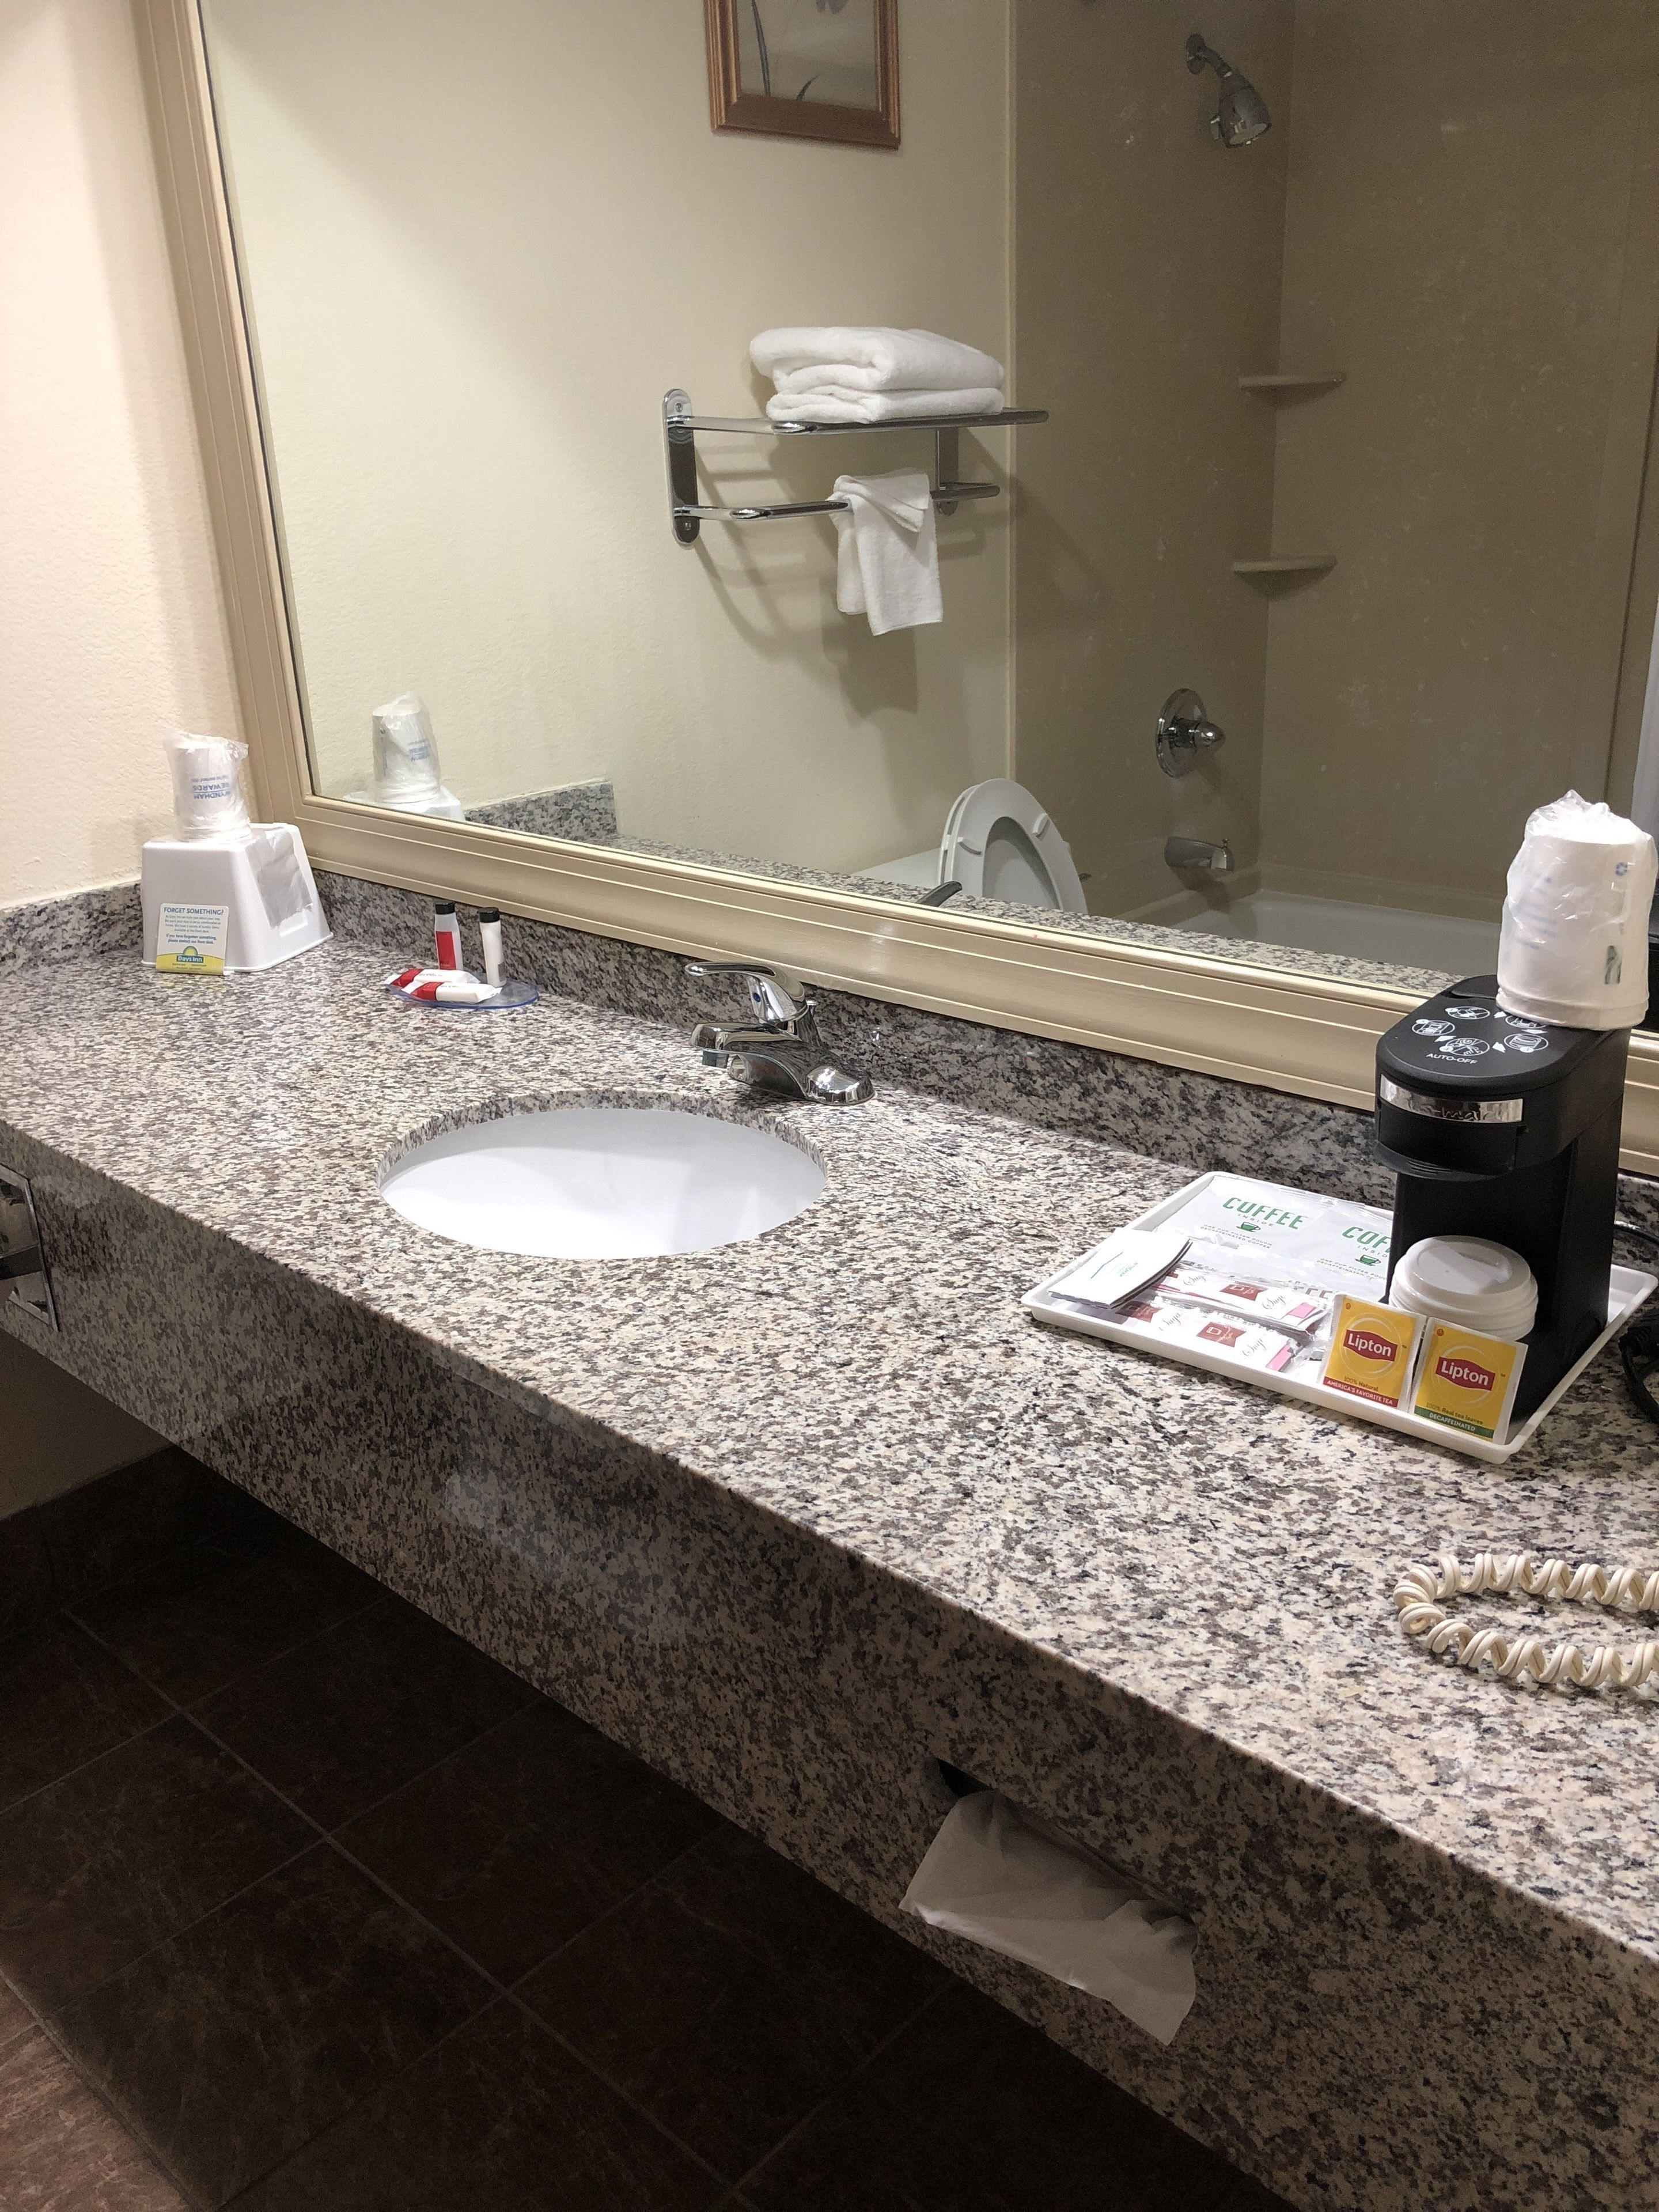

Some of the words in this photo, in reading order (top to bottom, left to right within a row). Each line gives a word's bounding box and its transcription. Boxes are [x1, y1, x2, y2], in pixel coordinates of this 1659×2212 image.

[1426, 1053, 1478, 1064] AUTO-OFF
[1222, 1197, 1308, 1230] COFFEE
[1237, 1214, 1275, 1227] INSIDE
[1200, 1225, 1246, 1241] DECAFFEINATED
[1247, 1240, 1271, 1249] COFFEE
[1251, 1237, 1272, 1247] POUCH
[1342, 1226, 1391, 1253] COF
[1348, 1266, 1369, 1274] FILTER
[1347, 1332, 1392, 1358] Lipton
[1343, 1376, 1358, 1384] 100%
[1358, 1381, 1379, 1392] Natural
[1441, 1360, 1488, 1386] Lipton
[1327, 1380, 1355, 1393] AMERICA'S
[1356, 1388, 1382, 1402] FAVORITE
[1382, 1397, 1393, 1405] TEA
[1426, 1402, 1441, 1411] 100%
[1442, 1407, 1455, 1415] Real
[1465, 1415, 1483, 1425] leaves
[1429, 1412, 1476, 1431] DECAFFEINATED
